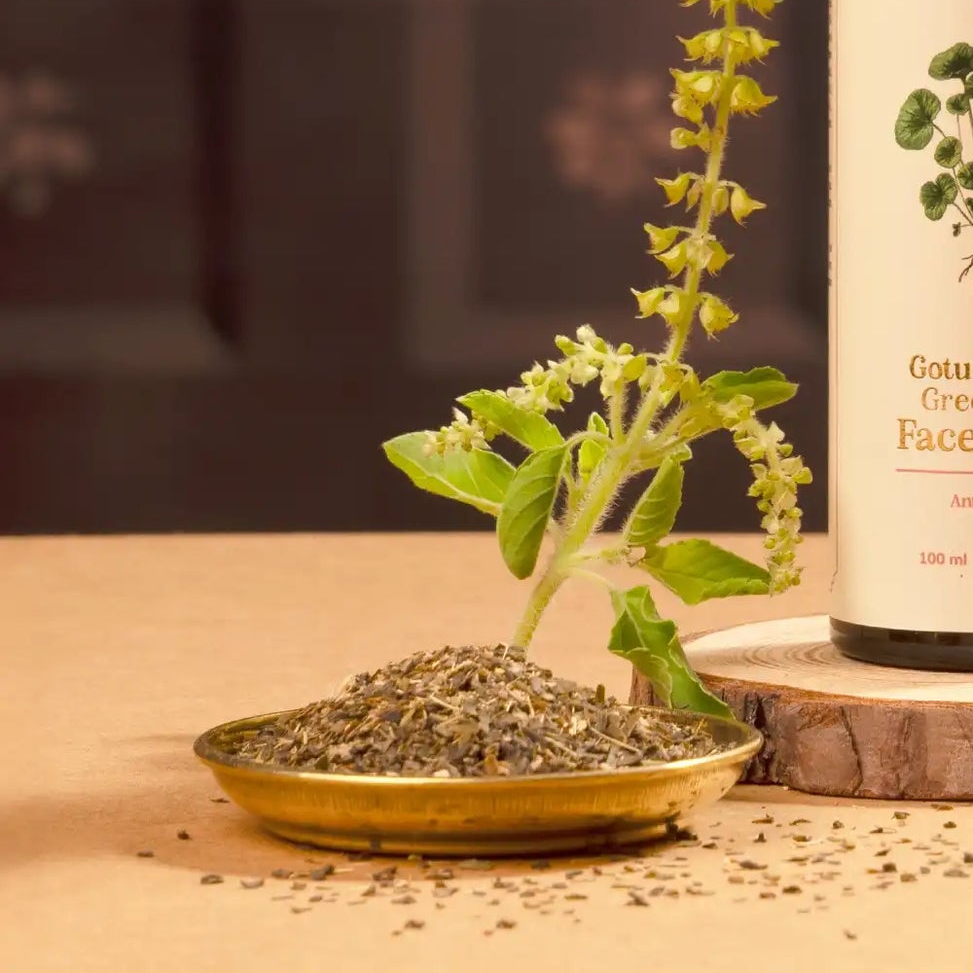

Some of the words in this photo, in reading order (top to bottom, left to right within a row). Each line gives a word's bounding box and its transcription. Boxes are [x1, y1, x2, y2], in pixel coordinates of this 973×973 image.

[909, 354, 970, 381] Gotu
[919, 552, 945, 566] 100
[949, 552, 967, 566] ml
